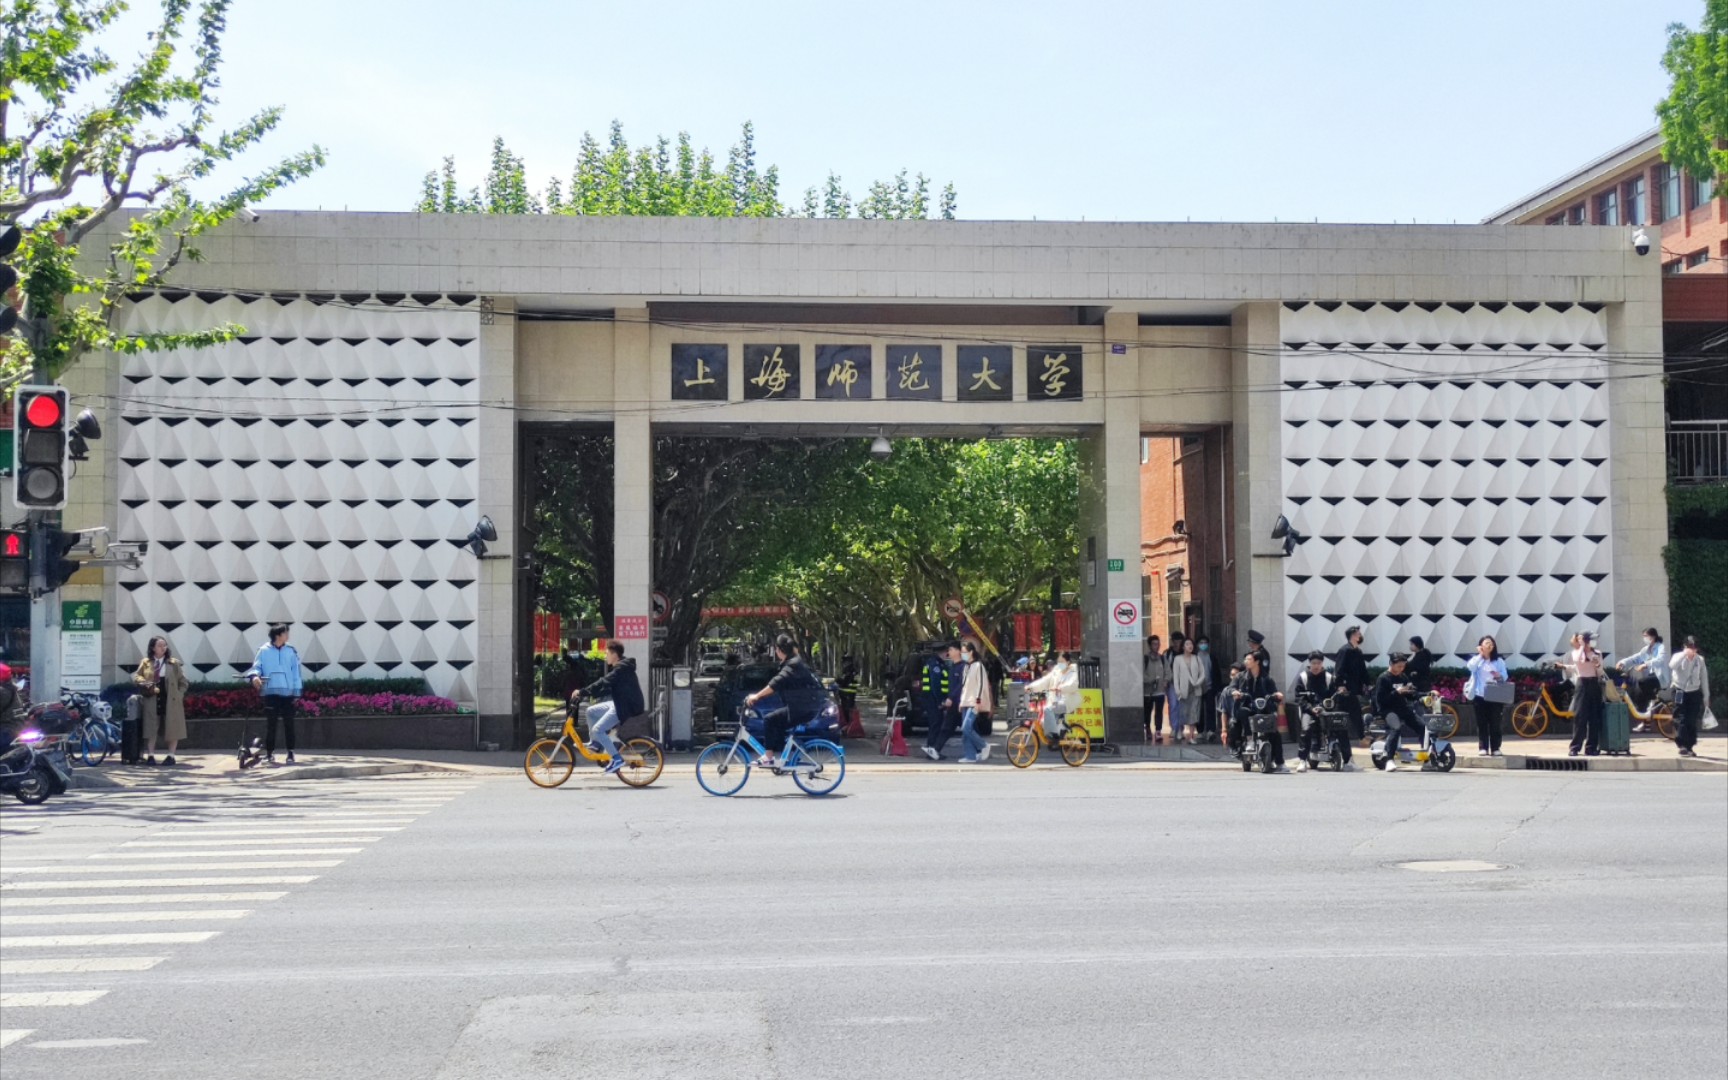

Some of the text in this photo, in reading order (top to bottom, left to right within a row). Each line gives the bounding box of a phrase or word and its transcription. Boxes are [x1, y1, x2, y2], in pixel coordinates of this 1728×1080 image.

[683, 346, 1071, 398] 上海师范大学
[1073, 707, 1103, 715] 客车辆
